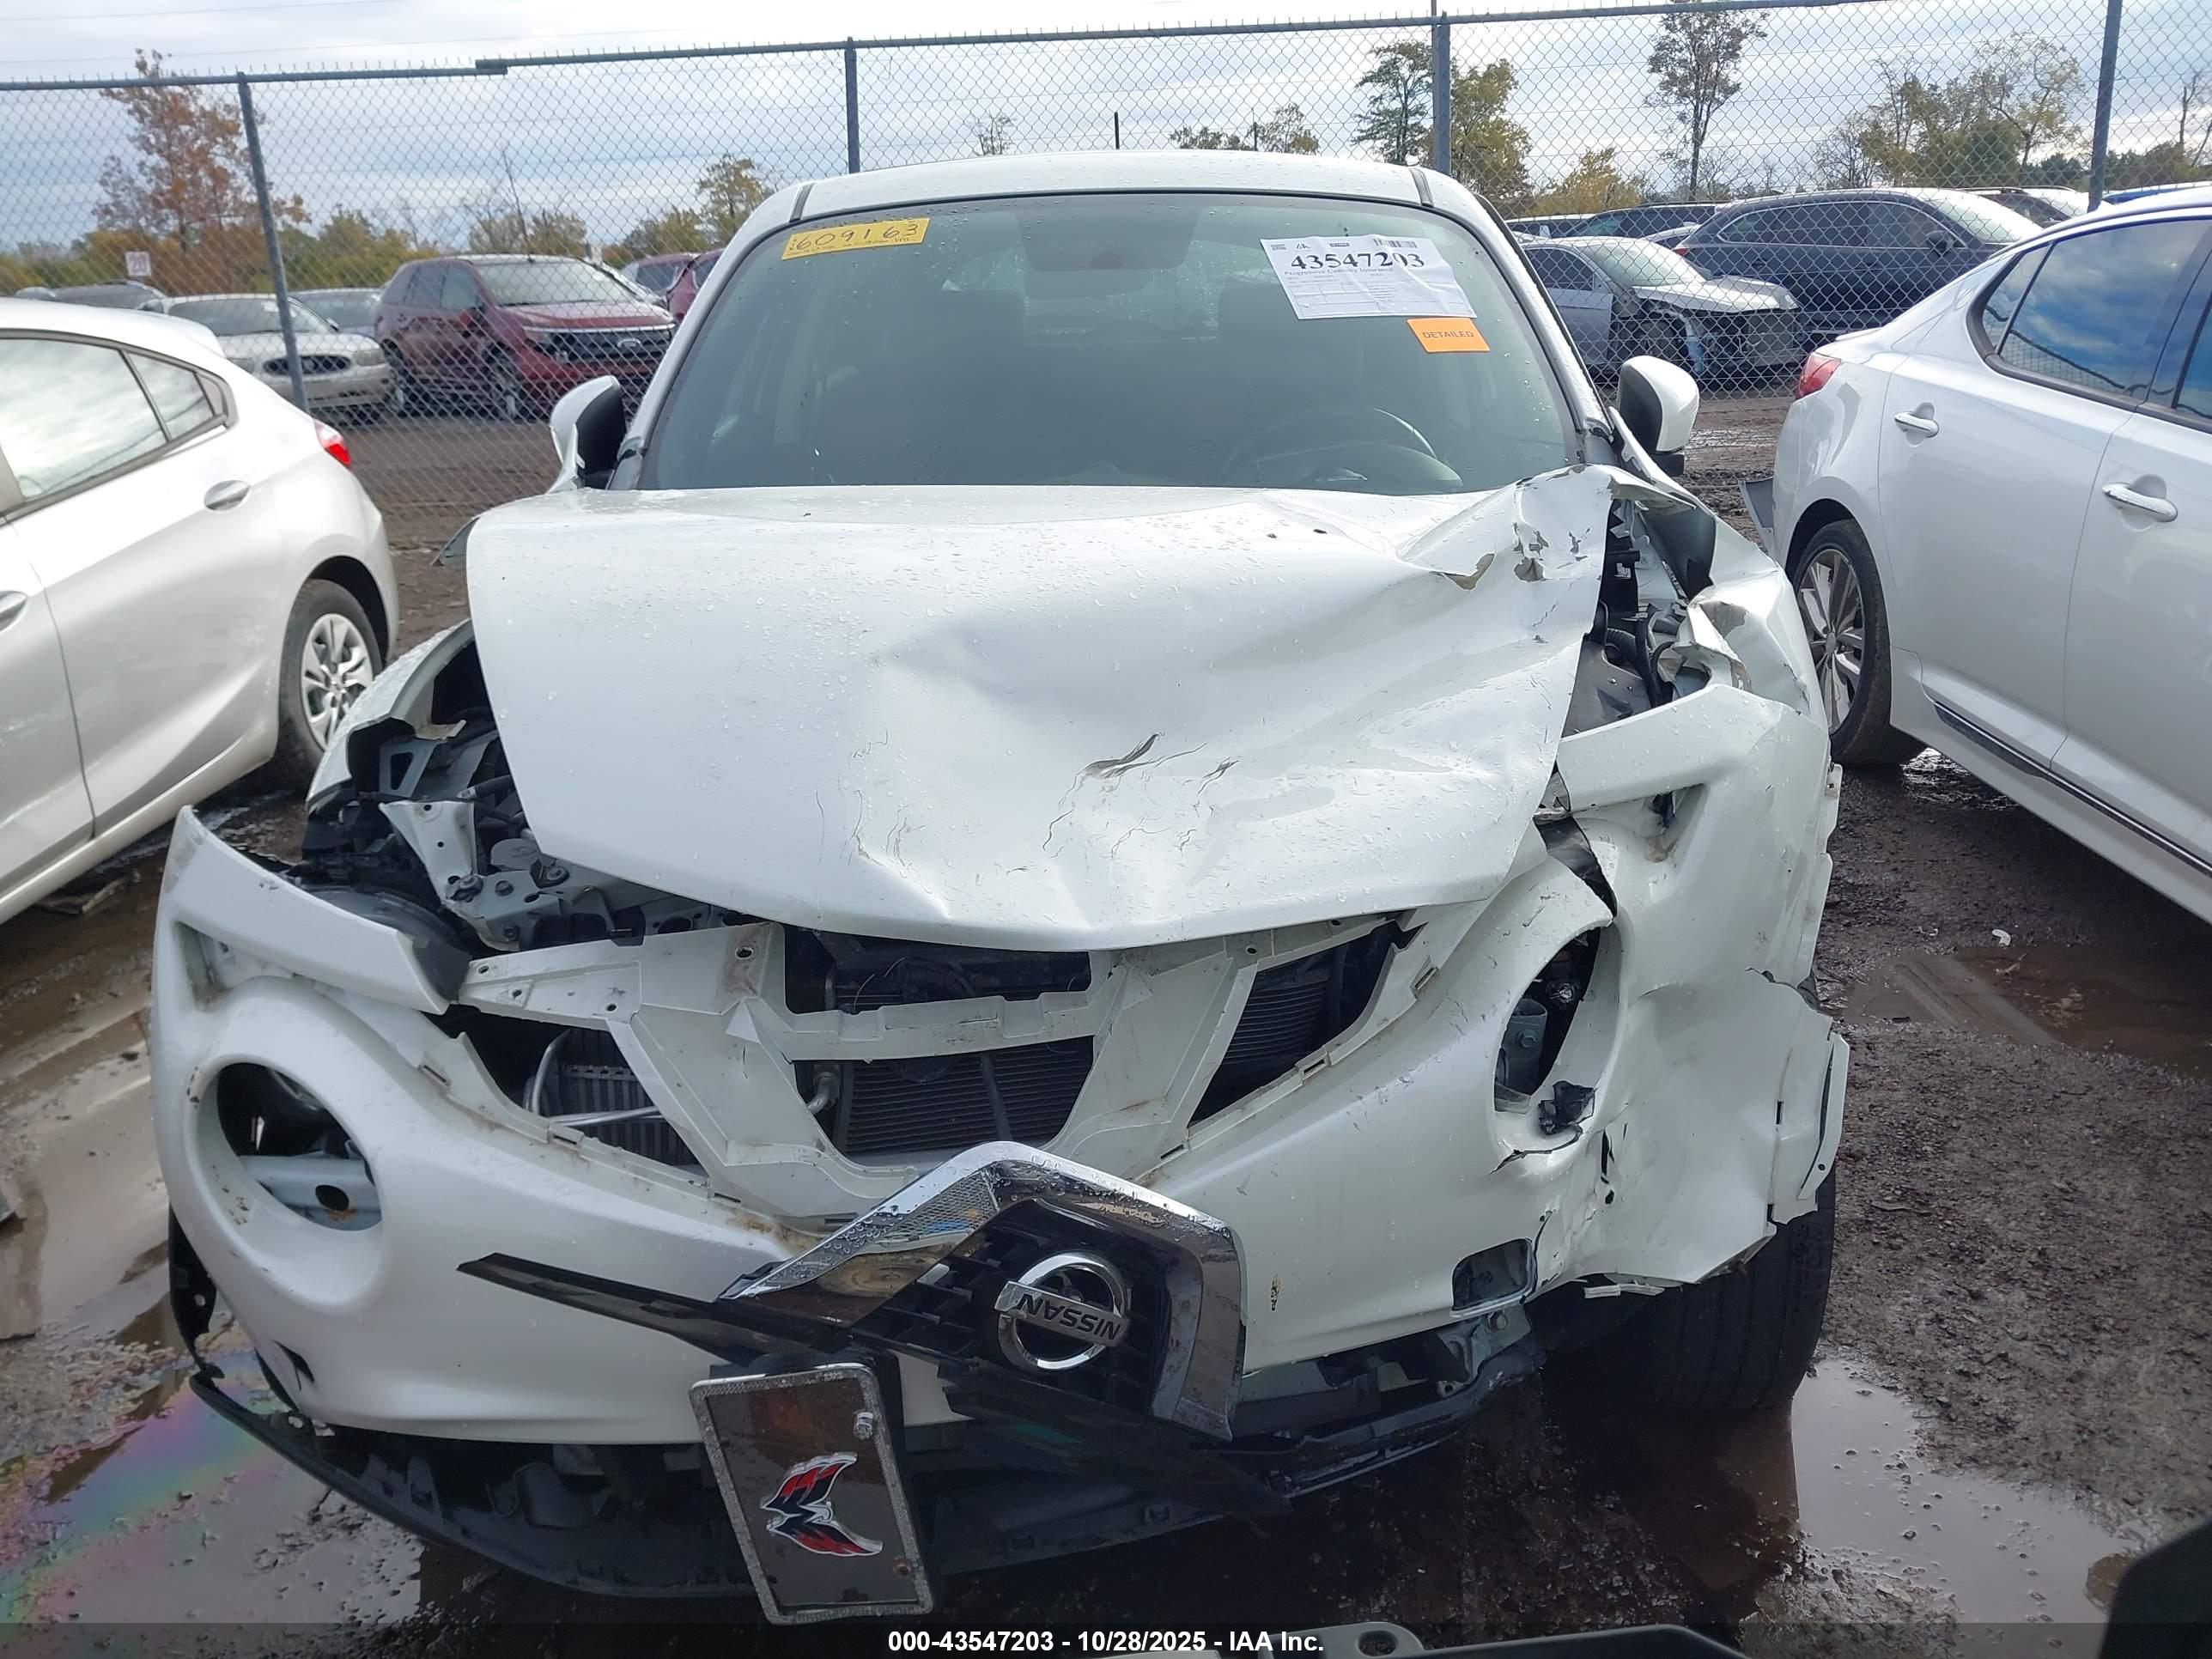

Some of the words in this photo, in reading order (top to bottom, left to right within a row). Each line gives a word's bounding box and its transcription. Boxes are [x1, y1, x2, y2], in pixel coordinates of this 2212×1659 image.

[797, 223, 918, 250] 609163
[1291, 252, 1425, 269] 43547203
[1017, 1293, 1121, 1340] NISSAN
